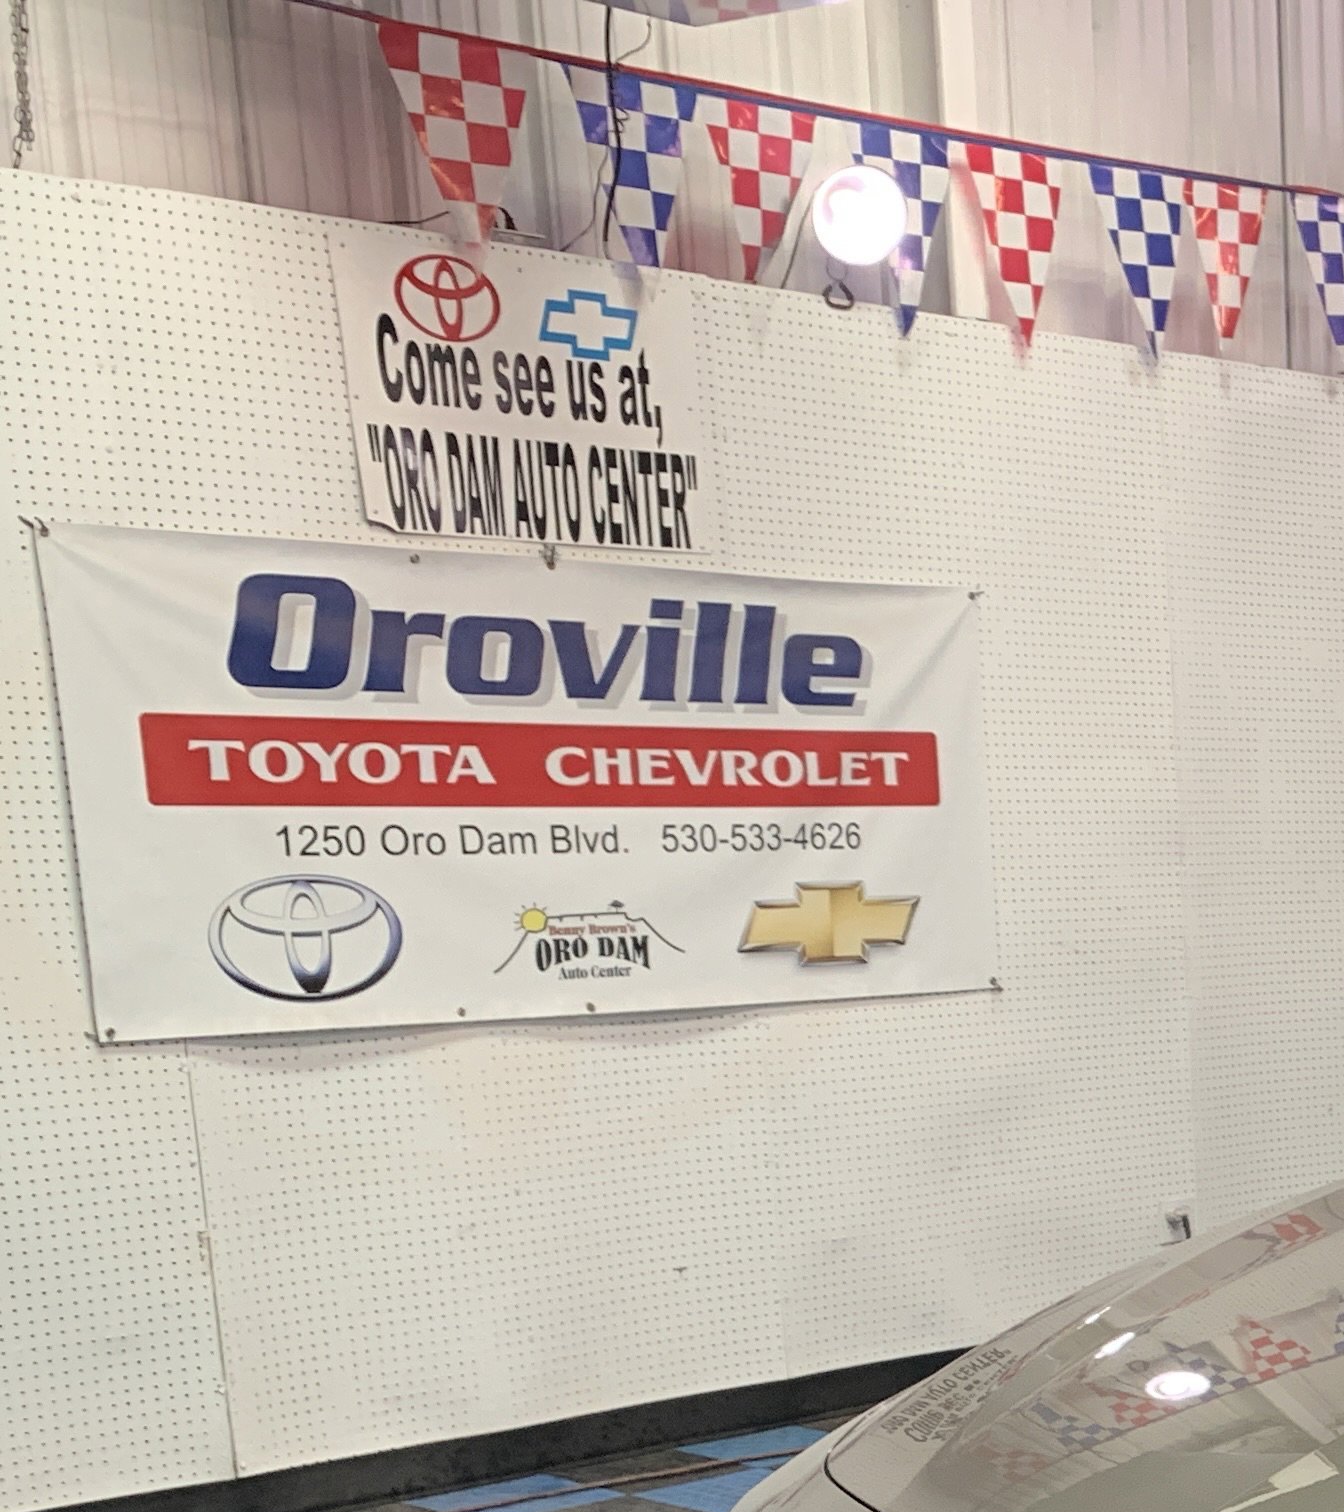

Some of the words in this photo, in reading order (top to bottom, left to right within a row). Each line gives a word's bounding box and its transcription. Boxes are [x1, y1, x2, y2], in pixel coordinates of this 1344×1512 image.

[375, 312, 482, 412] Come
[492, 348, 556, 419] see
[565, 357, 607, 423] us
[618, 347, 664, 449] at,
[366, 423, 443, 533] "ORO
[444, 430, 507, 538] DAM
[512, 438, 581, 542] AUTO
[588, 444, 699, 550] CENTER"
[226, 572, 866, 711] Oroville
[186, 738, 498, 786] TOYOTA
[543, 744, 910, 788] CHEVROLET
[274, 824, 367, 859] 1250
[379, 824, 448, 859] Oro
[458, 824, 539, 857] Dam
[551, 822, 631, 856] Blvd.
[660, 820, 862, 854] 530-533-4626
[547, 924, 586, 937] Benny
[588, 922, 637, 935] Brown's
[535, 936, 589, 972] ORO
[597, 934, 651, 970] DAM
[558, 966, 589, 981] Auto
[590, 965, 632, 979] Center
